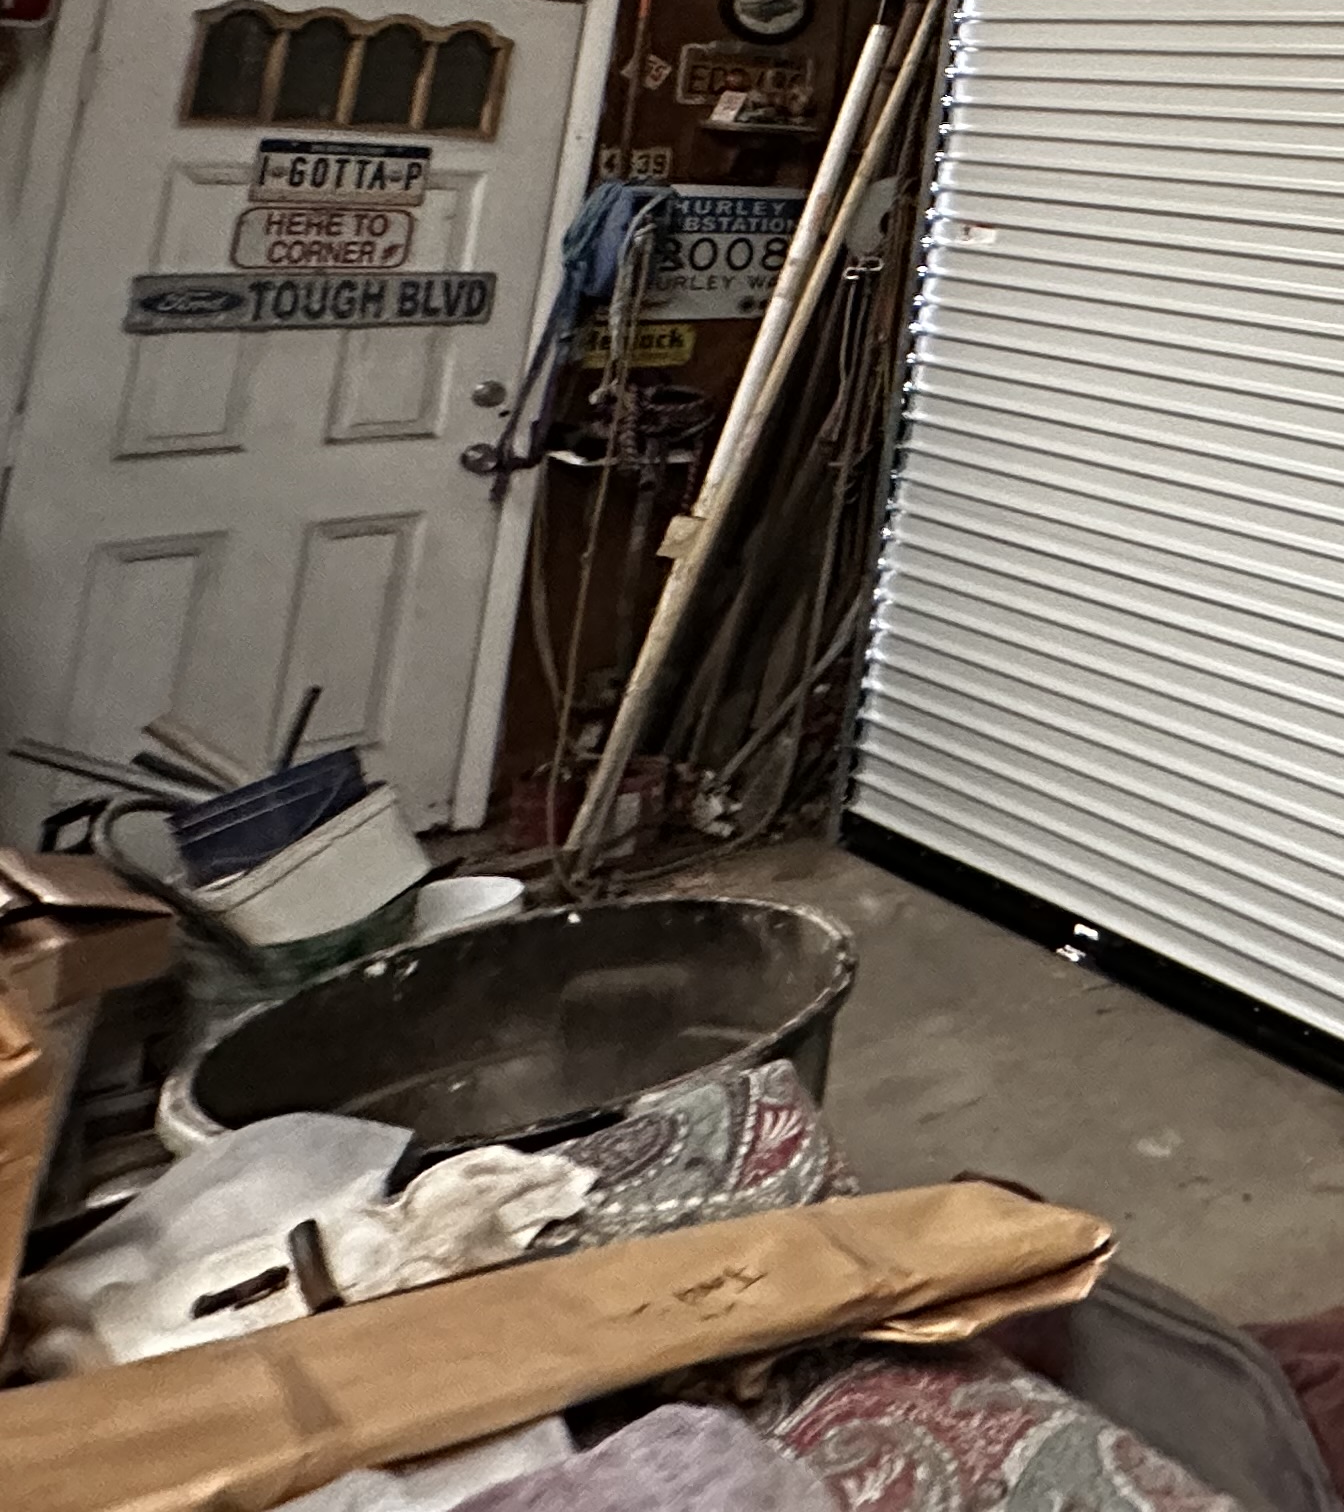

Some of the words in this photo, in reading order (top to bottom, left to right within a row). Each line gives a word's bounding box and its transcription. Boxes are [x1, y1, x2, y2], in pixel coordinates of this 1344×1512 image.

[263, 212, 348, 238] HERE
[353, 213, 389, 237] TO
[267, 240, 375, 265] CORNER
[248, 279, 386, 321] TOUGH
[397, 277, 488, 319] BLVD
